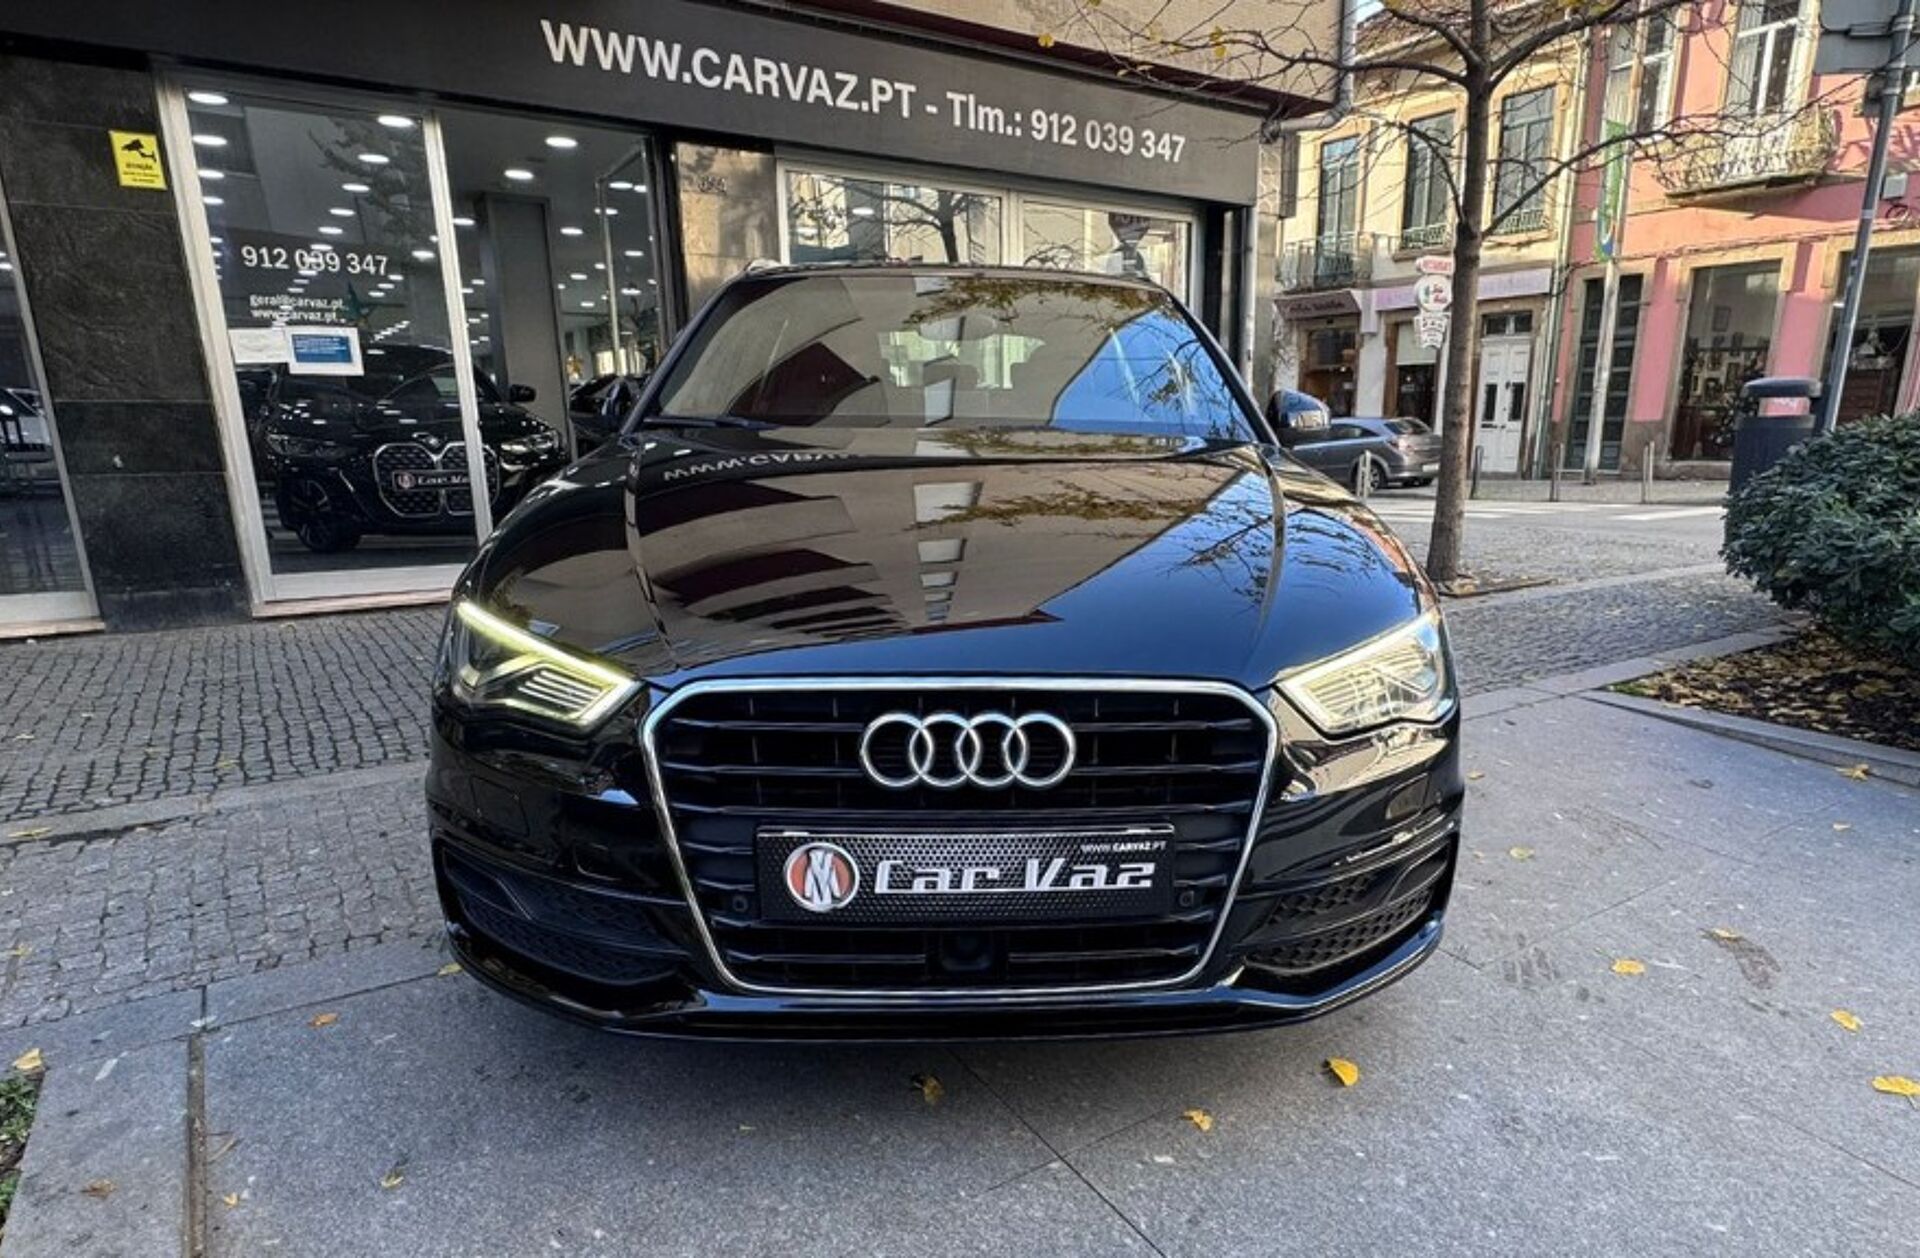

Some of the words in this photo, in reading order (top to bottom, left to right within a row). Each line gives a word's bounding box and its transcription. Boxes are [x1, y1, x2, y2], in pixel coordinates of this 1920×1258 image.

[541, 19, 917, 119] WWW.CARVAZ.PT
[946, 91, 1022, 136] Tlm.:
[1031, 108, 1078, 145] 912
[1085, 120, 1134, 155] 039
[1140, 130, 1186, 162] 347
[241, 245, 289, 269] 912
[294, 248, 340, 272] 039
[346, 252, 388, 276] 347
[874, 859, 1000, 894] Car
